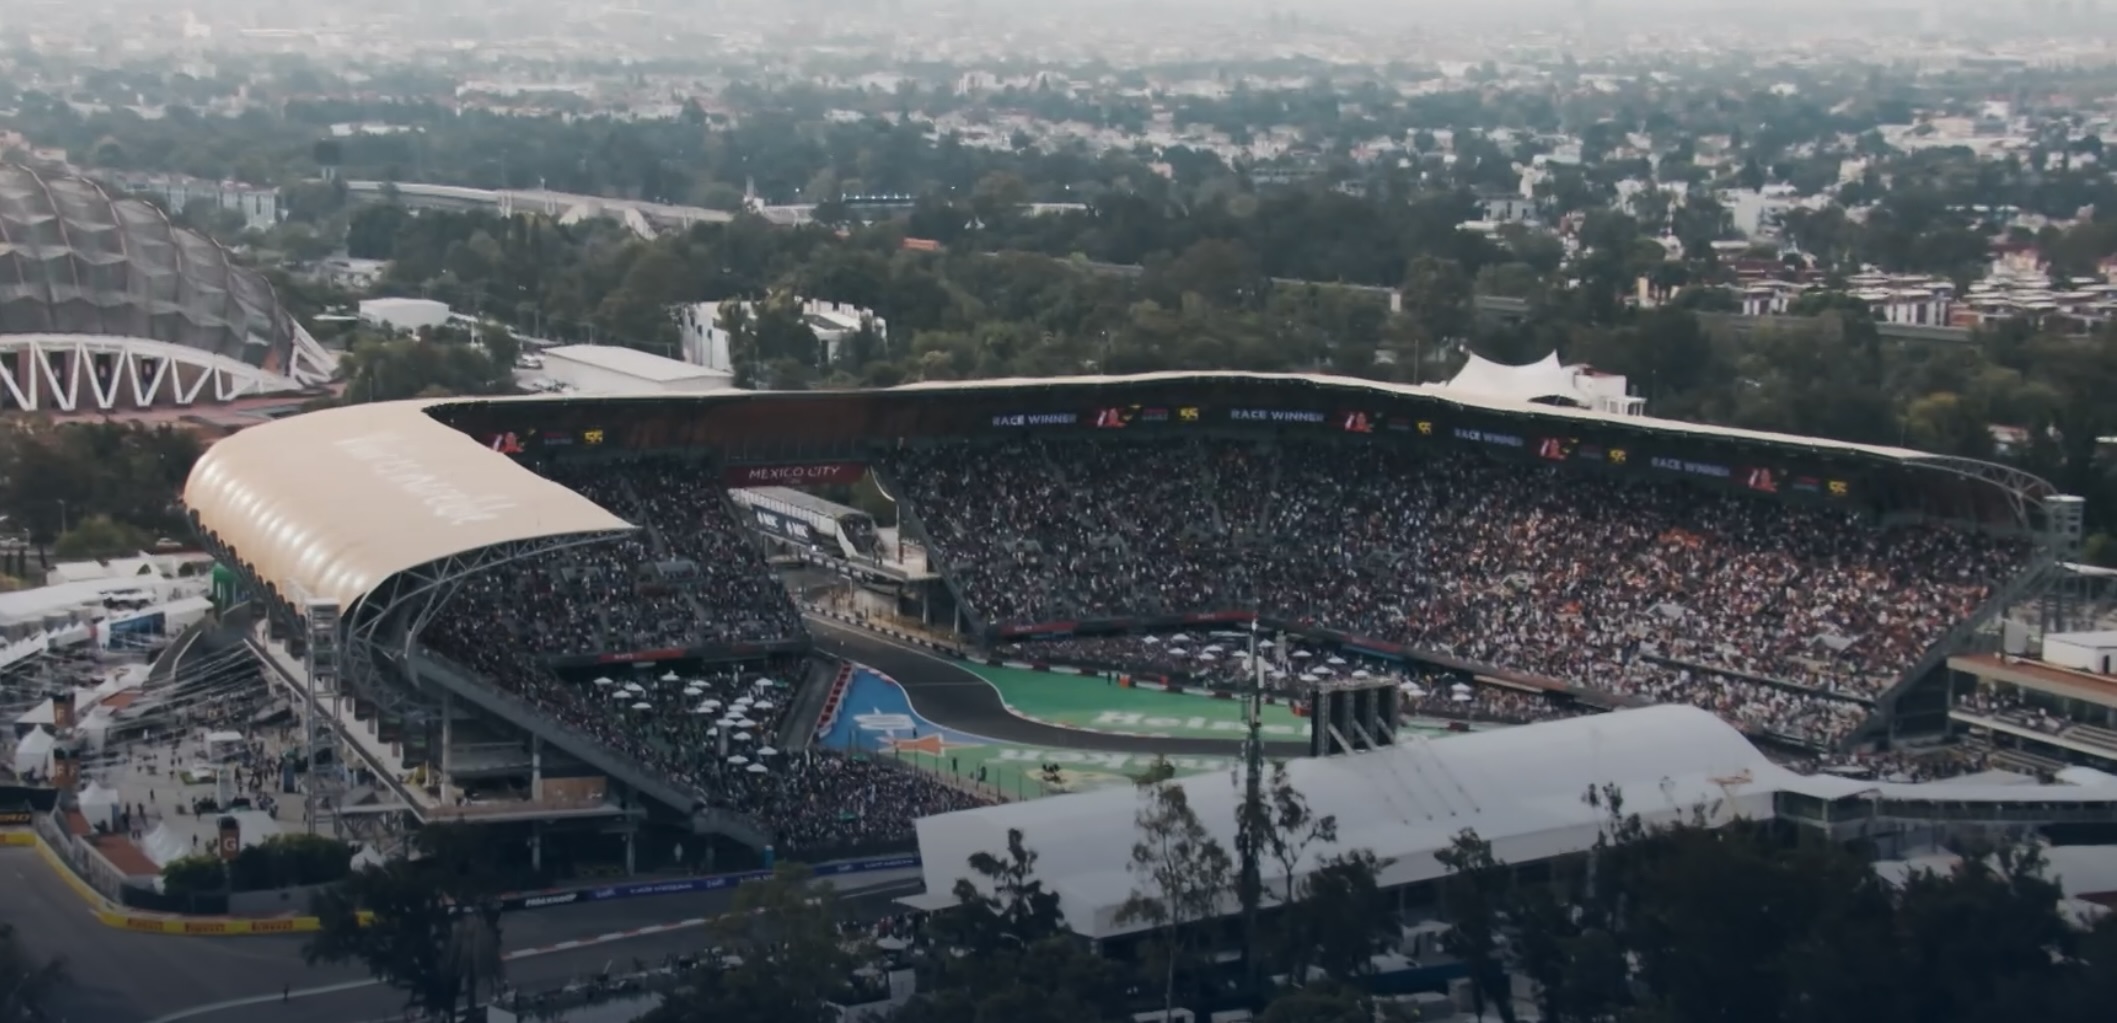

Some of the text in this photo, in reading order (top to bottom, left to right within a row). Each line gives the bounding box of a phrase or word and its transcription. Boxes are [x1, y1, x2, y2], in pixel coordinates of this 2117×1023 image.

[992, 412, 1077, 426] RACE WINNER
[1231, 408, 1325, 422] RACE WINNER
[1453, 427, 1481, 441] RACE
[1650, 456, 1682, 470] RACE
[749, 465, 840, 480] MEXICO CITY
[224, 836, 237, 852] G
